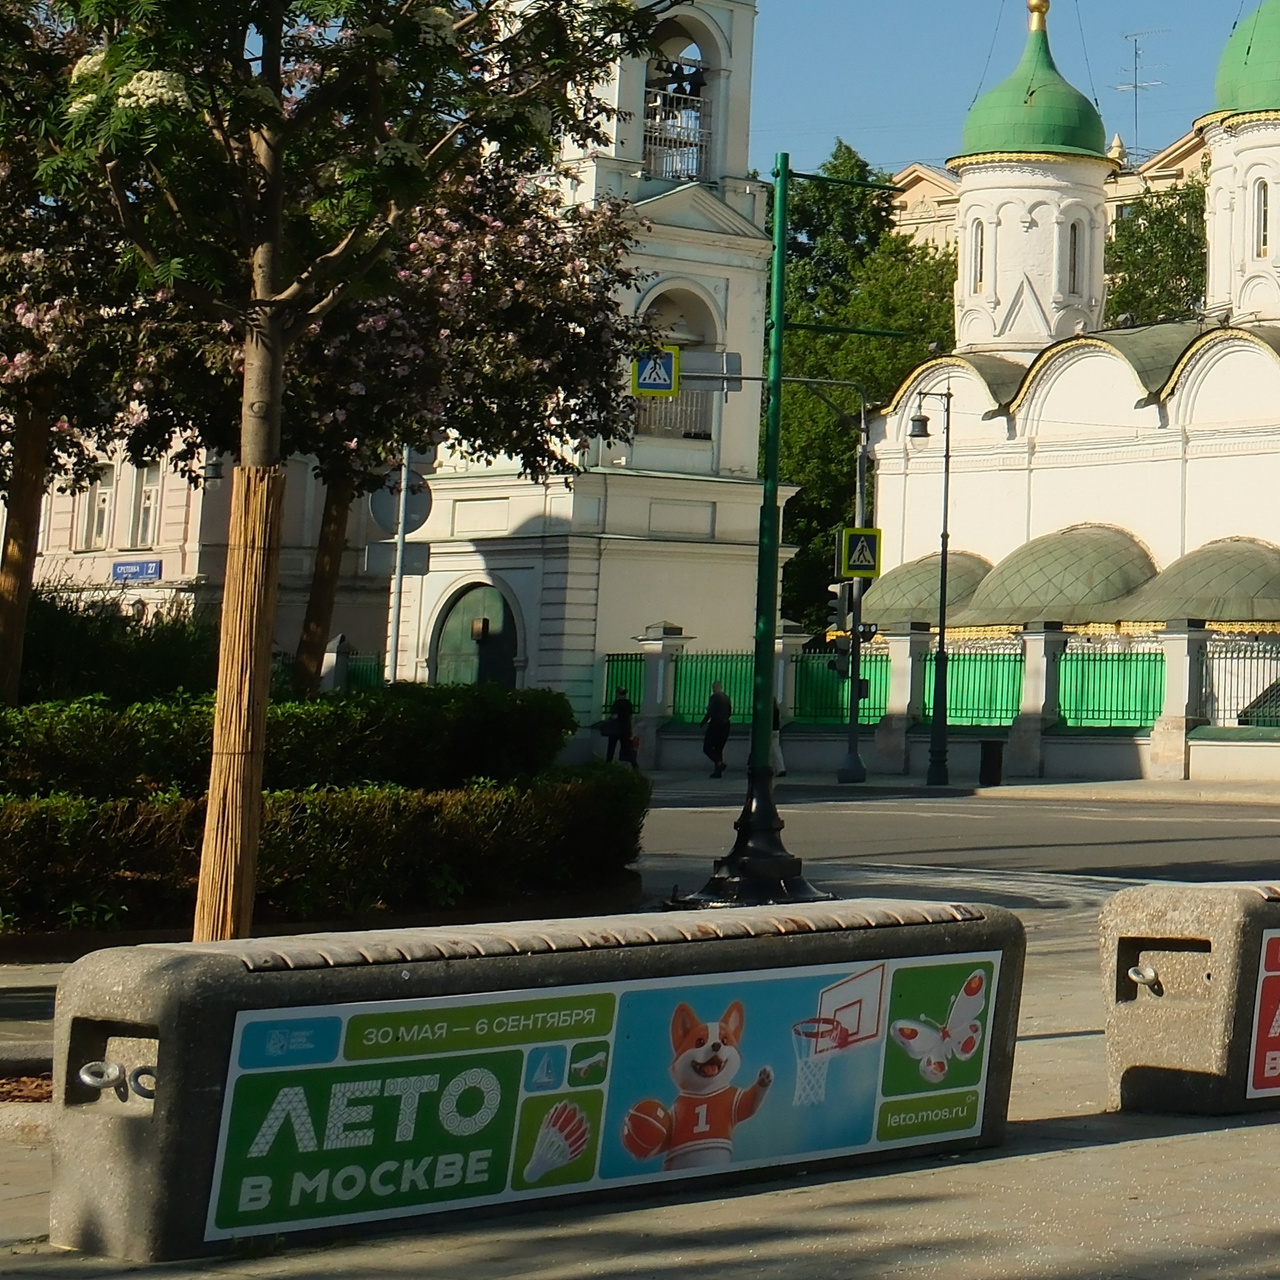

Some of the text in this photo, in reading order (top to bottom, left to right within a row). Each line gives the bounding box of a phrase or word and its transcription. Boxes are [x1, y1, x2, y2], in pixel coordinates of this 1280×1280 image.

[363, 1027, 393, 1045] 30
[398, 1022, 447, 1042] МАЯ
[475, 1020, 488, 1035] 6
[493, 1008, 596, 1033] СЕНТЯБРЯ
[247, 1067, 501, 1158] ЛЕТО
[692, 1103, 711, 1134] 1
[886, 1106, 967, 1128] leto.mos.ru
[238, 1148, 493, 1213] В МОСКВЕ
